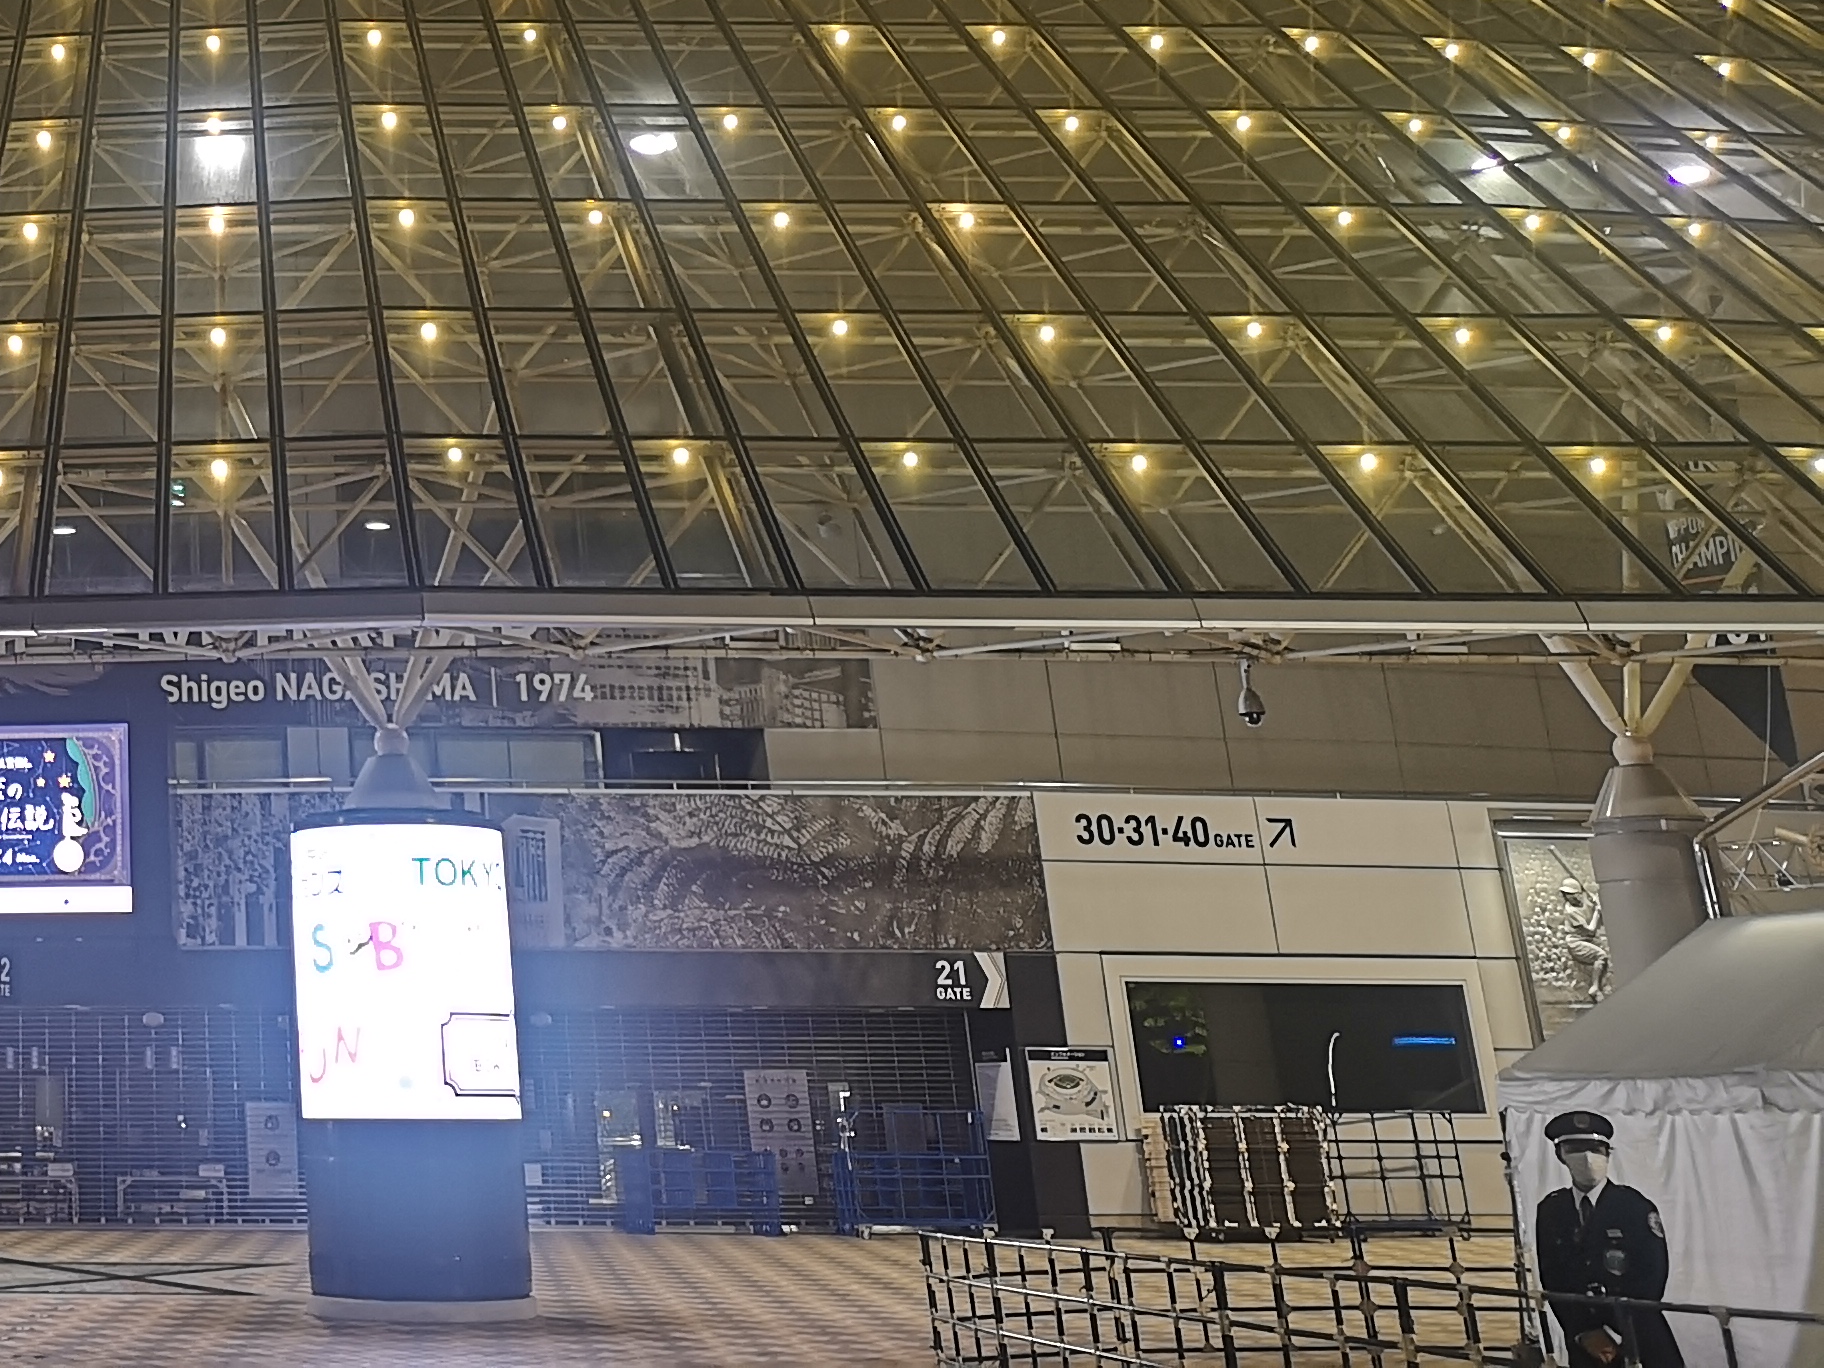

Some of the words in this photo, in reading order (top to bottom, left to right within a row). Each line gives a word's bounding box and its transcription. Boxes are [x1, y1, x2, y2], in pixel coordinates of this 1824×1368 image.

[160, 673, 266, 710] Shigeo
[514, 672, 595, 703] 1974
[1214, 833, 1255, 848] GATE
[935, 960, 966, 985] 21
[936, 987, 971, 1000] GATE
